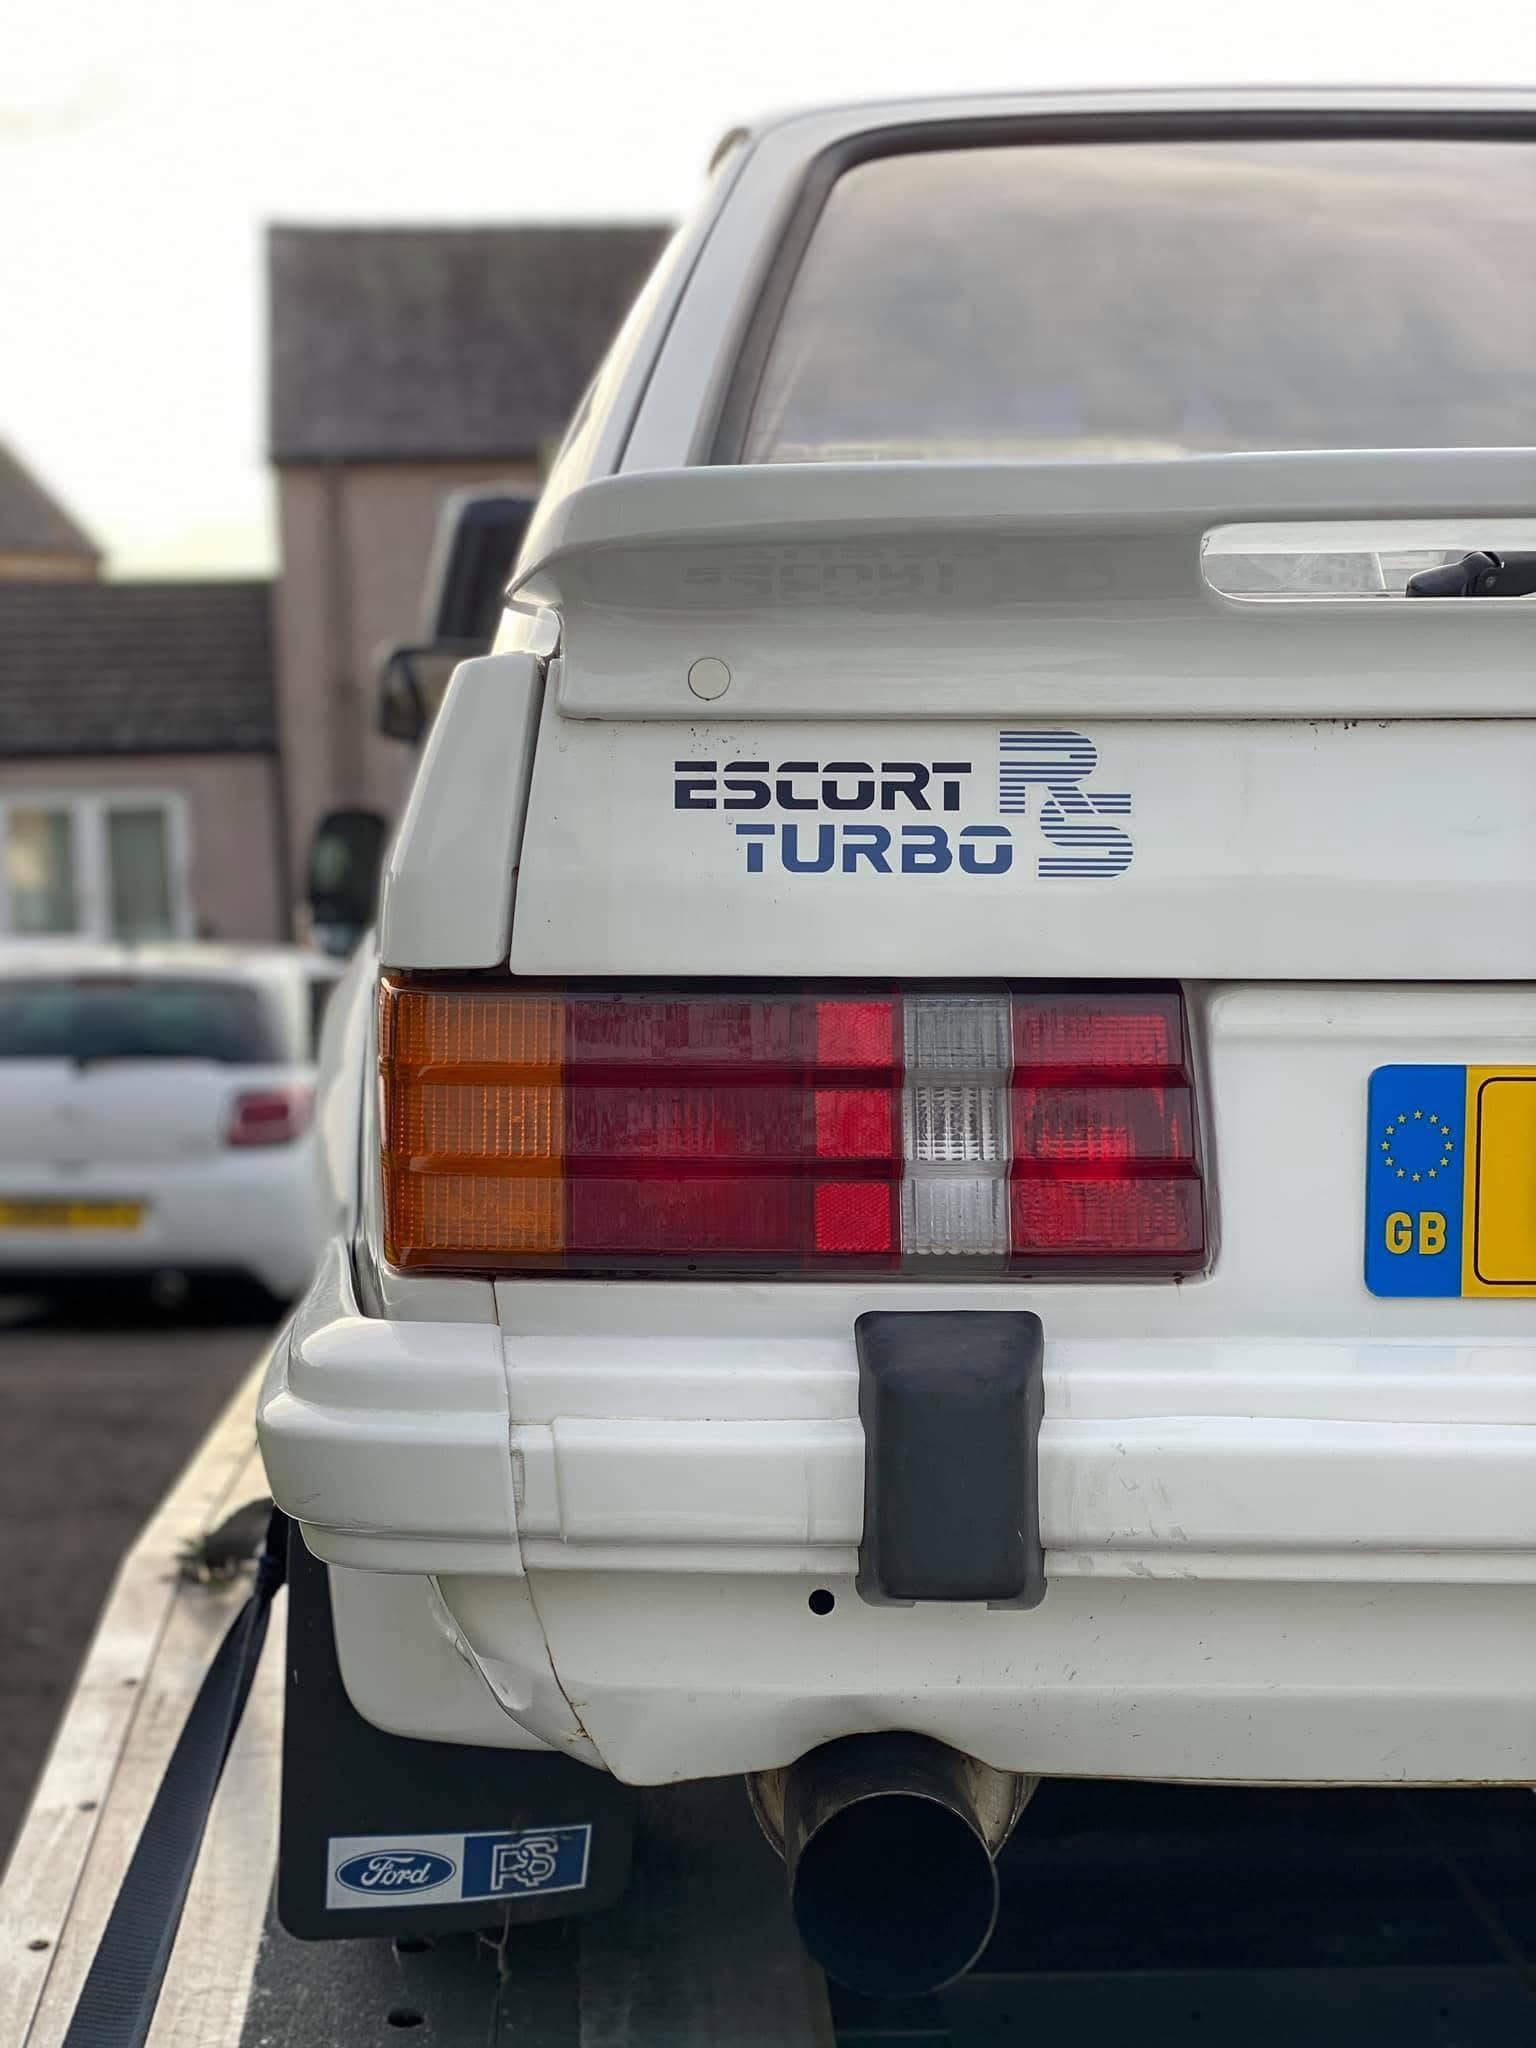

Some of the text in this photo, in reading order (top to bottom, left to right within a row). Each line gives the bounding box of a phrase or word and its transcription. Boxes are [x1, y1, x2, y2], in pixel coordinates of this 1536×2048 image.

[674, 761, 972, 811] ESCORT
[736, 824, 1013, 873] TURBO
[1384, 1211, 1447, 1255] GB
[361, 1857, 431, 1886] Ford
